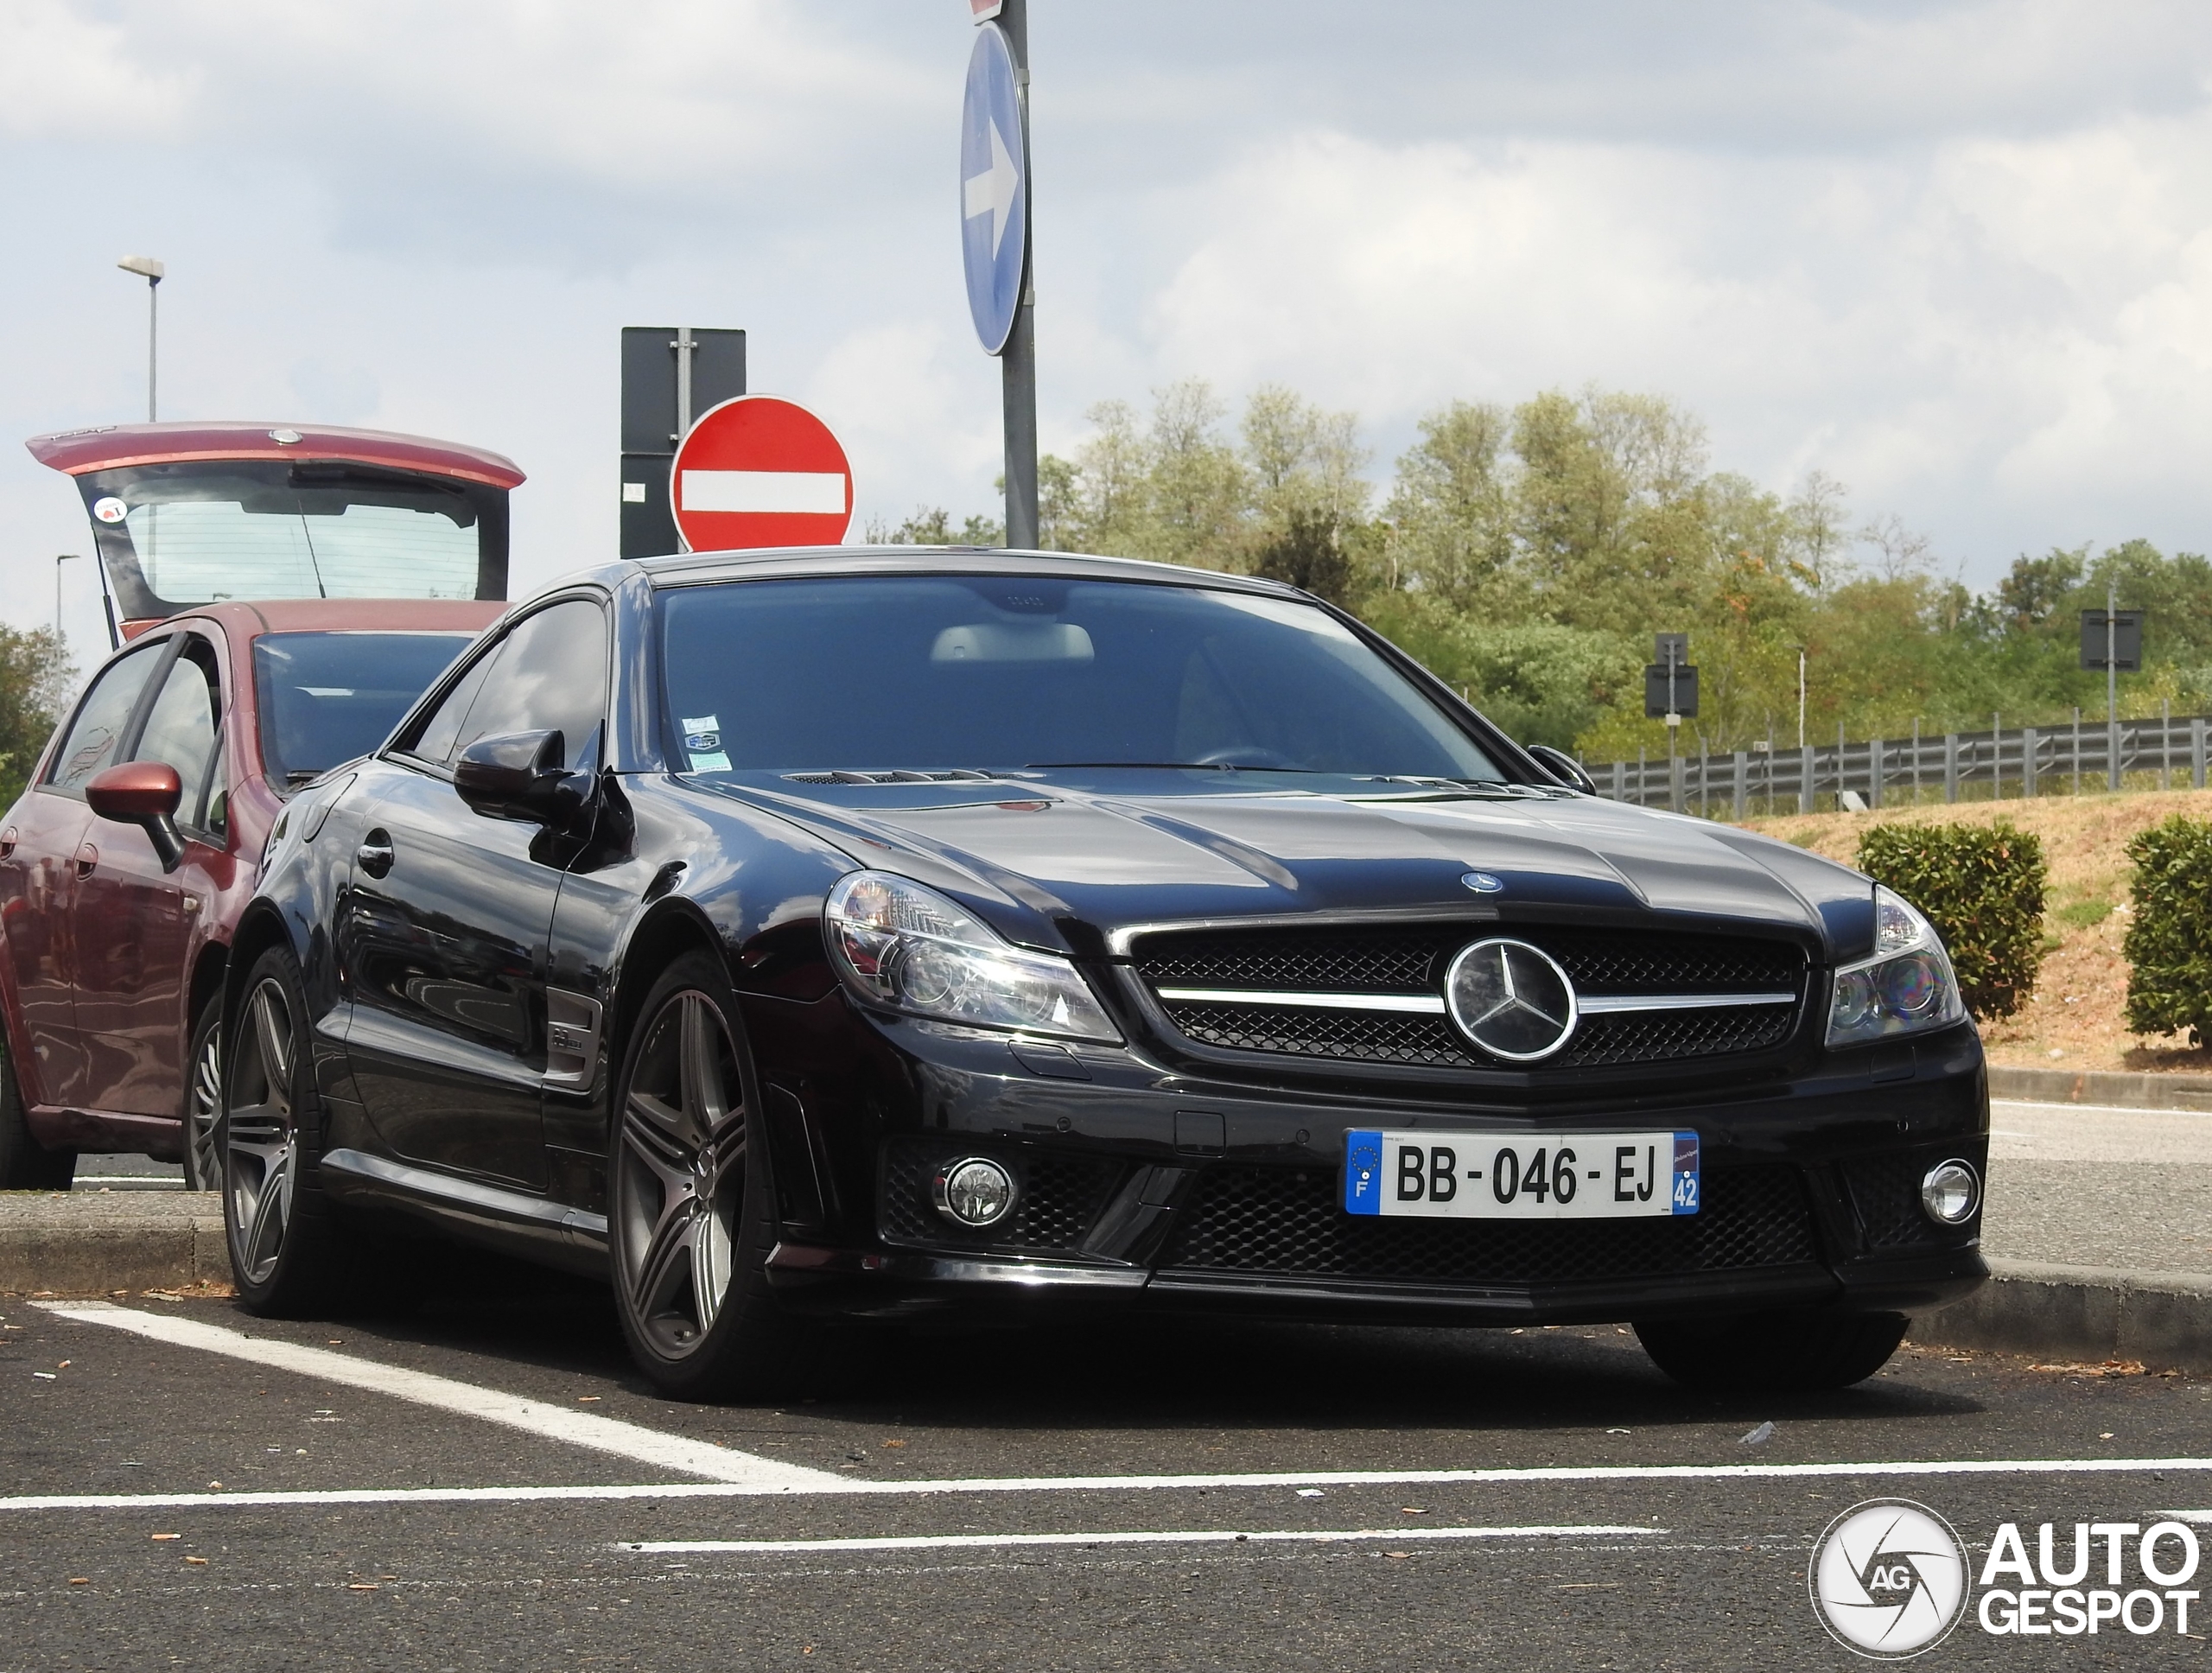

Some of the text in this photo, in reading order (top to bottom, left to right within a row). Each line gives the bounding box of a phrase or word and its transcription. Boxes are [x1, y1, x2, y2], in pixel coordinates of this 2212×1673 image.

[1397, 1146, 1655, 1204] BB-046-EJ
[1356, 1181, 1368, 1197] F
[1674, 1179, 1697, 1206] 42
